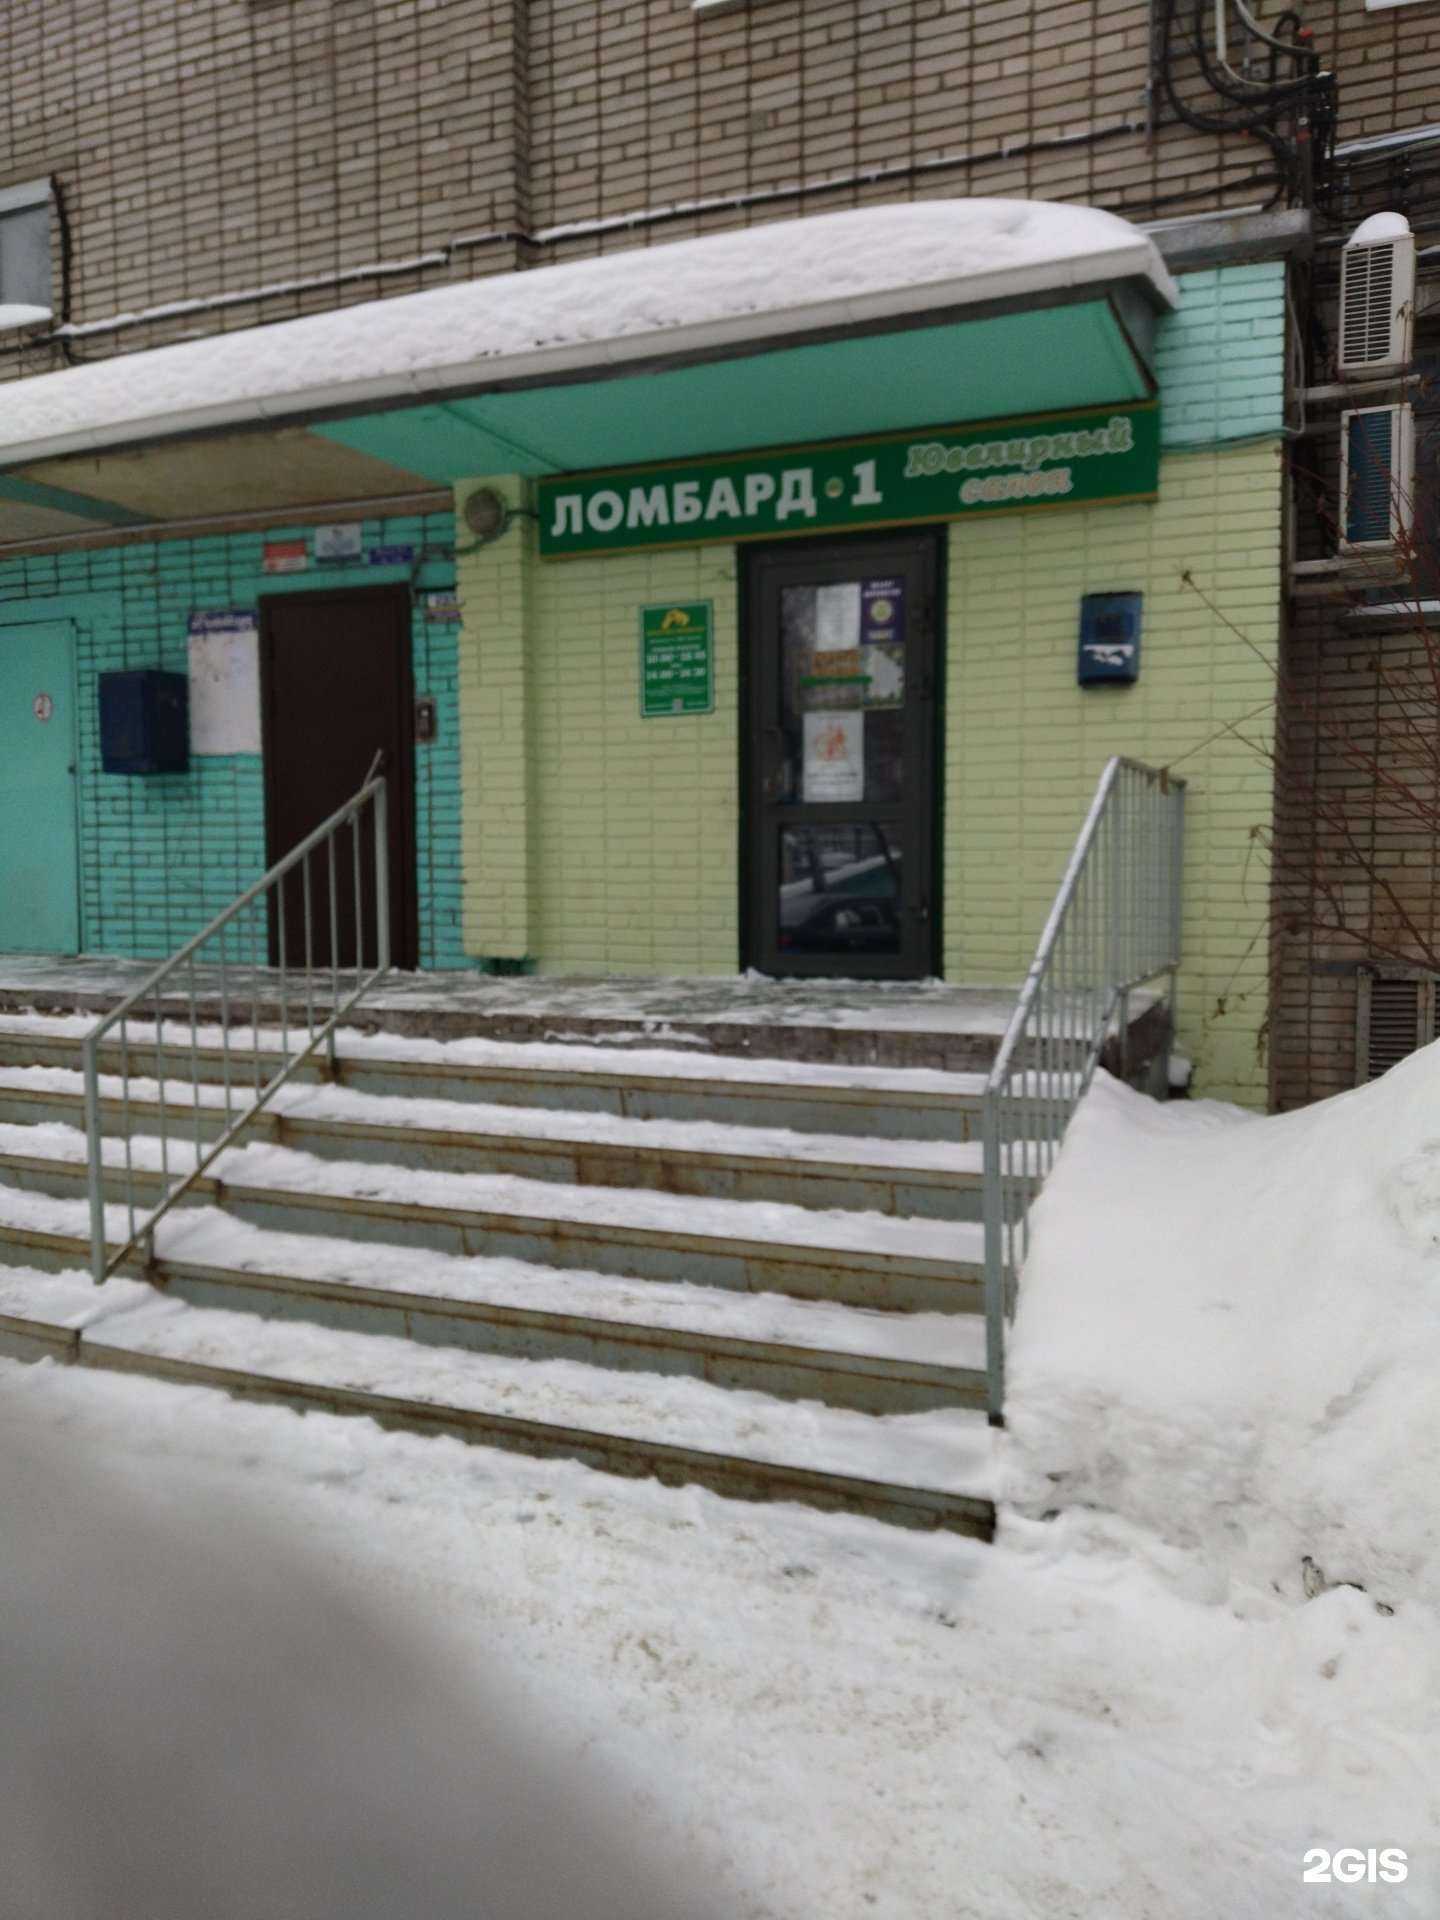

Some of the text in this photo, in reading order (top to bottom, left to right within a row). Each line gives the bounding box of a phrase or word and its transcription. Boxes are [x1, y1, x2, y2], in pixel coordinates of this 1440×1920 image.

[904, 416, 1134, 478] Ювелирный
[551, 459, 882, 537] ЛОМБАРД 1
[959, 467, 1074, 504] салон
